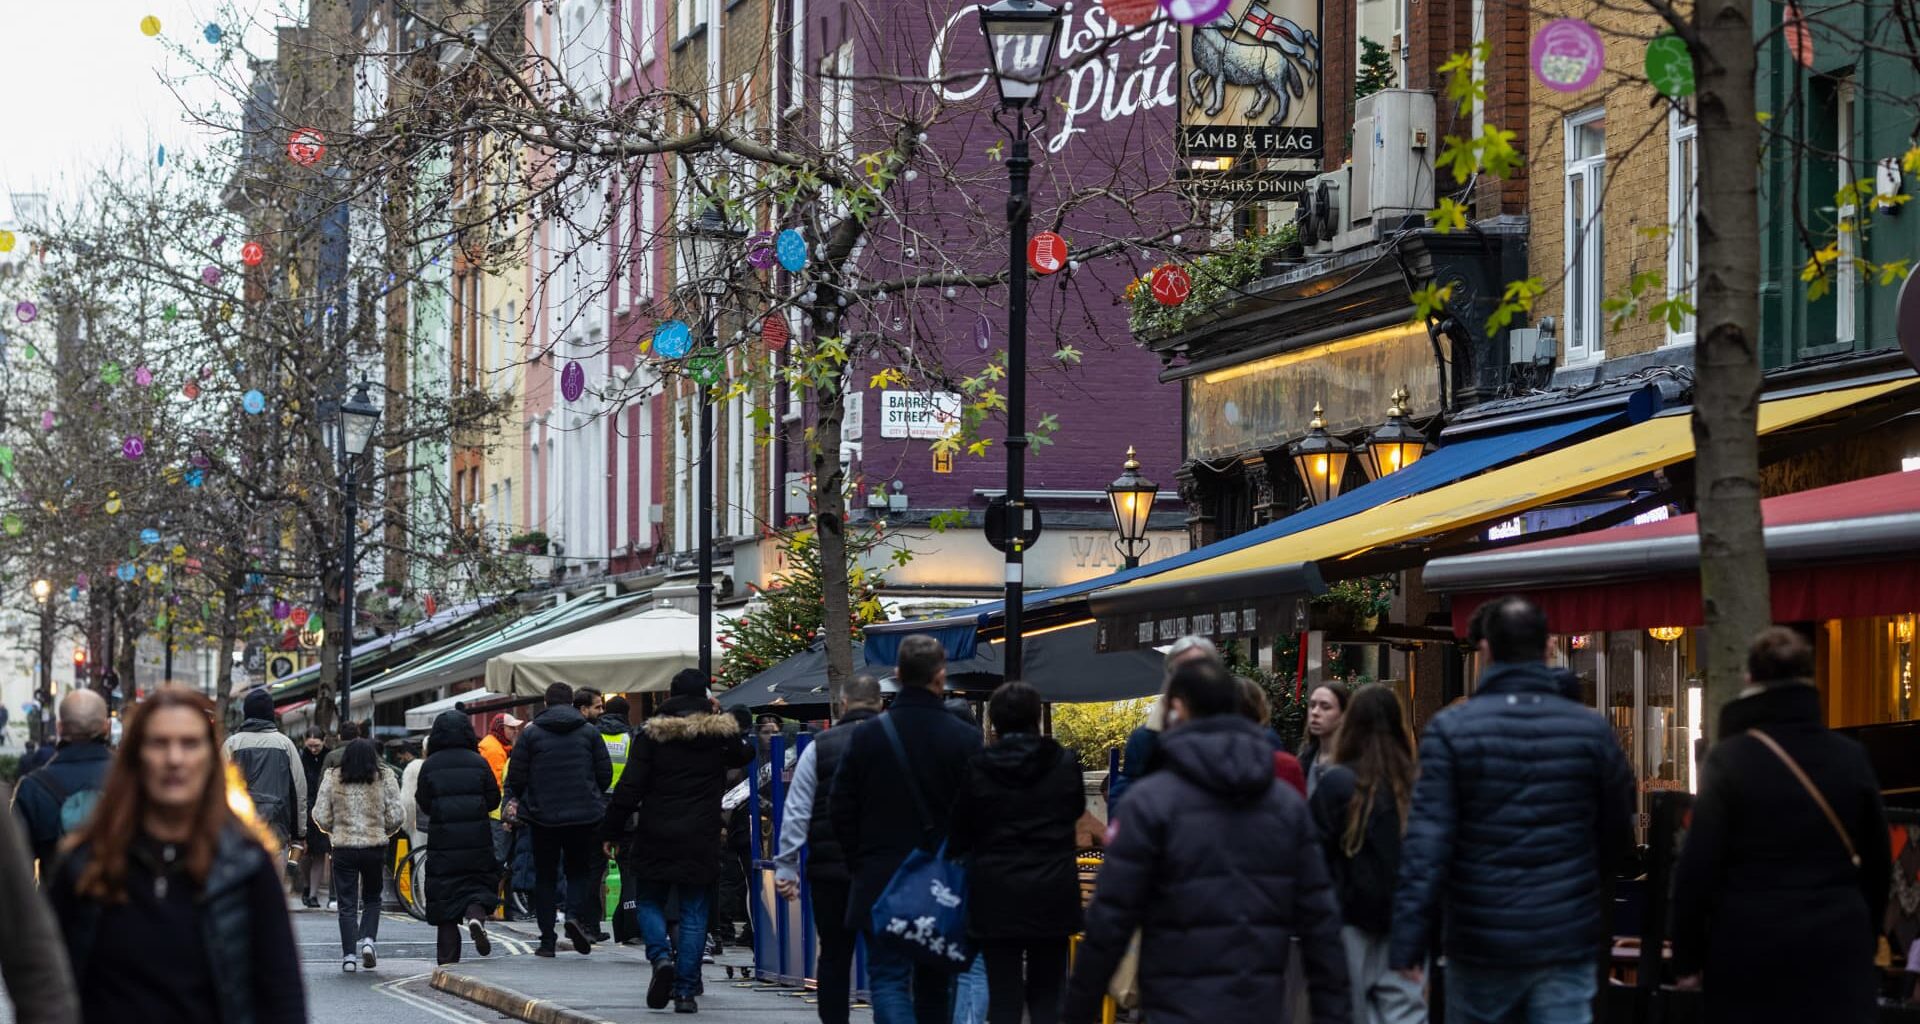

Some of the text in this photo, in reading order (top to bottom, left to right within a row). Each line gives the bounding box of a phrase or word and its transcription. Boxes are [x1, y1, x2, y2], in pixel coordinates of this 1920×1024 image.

[1185, 133, 1313, 150] LAMB & FLAG
[1259, 179, 1305, 192] DININ
[889, 397, 941, 408] BARRETT
[889, 410, 931, 422] STREET
[935, 452, 950, 471] H
